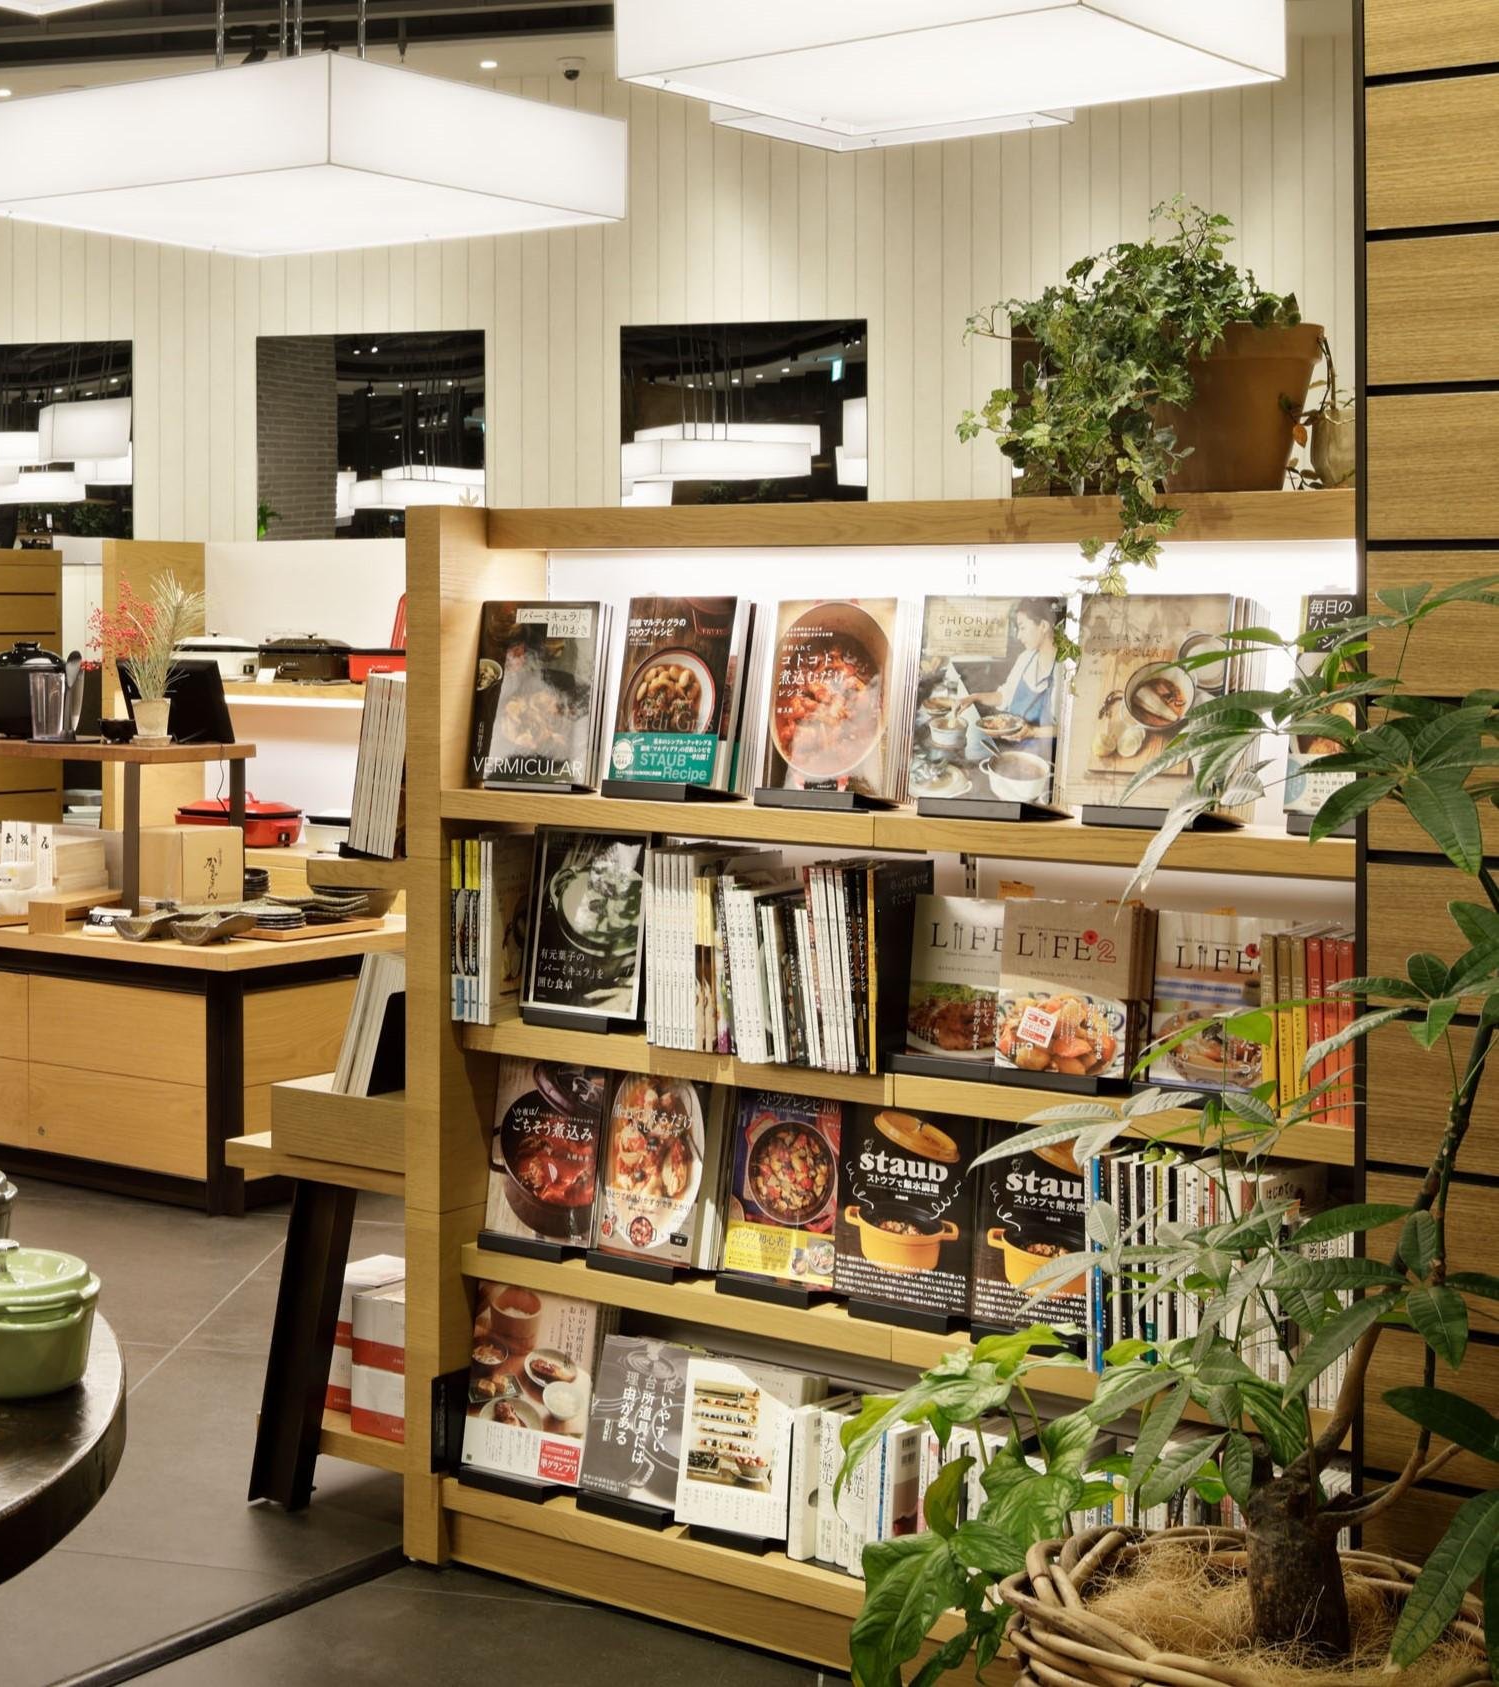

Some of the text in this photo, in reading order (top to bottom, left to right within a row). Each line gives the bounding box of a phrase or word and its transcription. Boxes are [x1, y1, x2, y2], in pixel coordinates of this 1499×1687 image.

[1309, 599, 1353, 616] 毎日の
[780, 652, 833, 667] コトコト
[778, 669, 845, 686] 煮込むだけ
[778, 688, 804, 698] レシピ
[472, 756, 583, 777] VERMICULAR
[639, 752, 687, 767] STAUB
[661, 766, 708, 782] Recipe
[1096, 938, 1117, 963] 2
[537, 976, 573, 991] 囲む食卓
[512, 1117, 594, 1142] ごちそう煮込み
[860, 1150, 949, 1183] staub
[1005, 1169, 1085, 1200] stau
[615, 1370, 640, 1446] 理由がある
[652, 1378, 677, 1453] 使いやすい
[631, 1374, 658, 1465] 台所道具には
